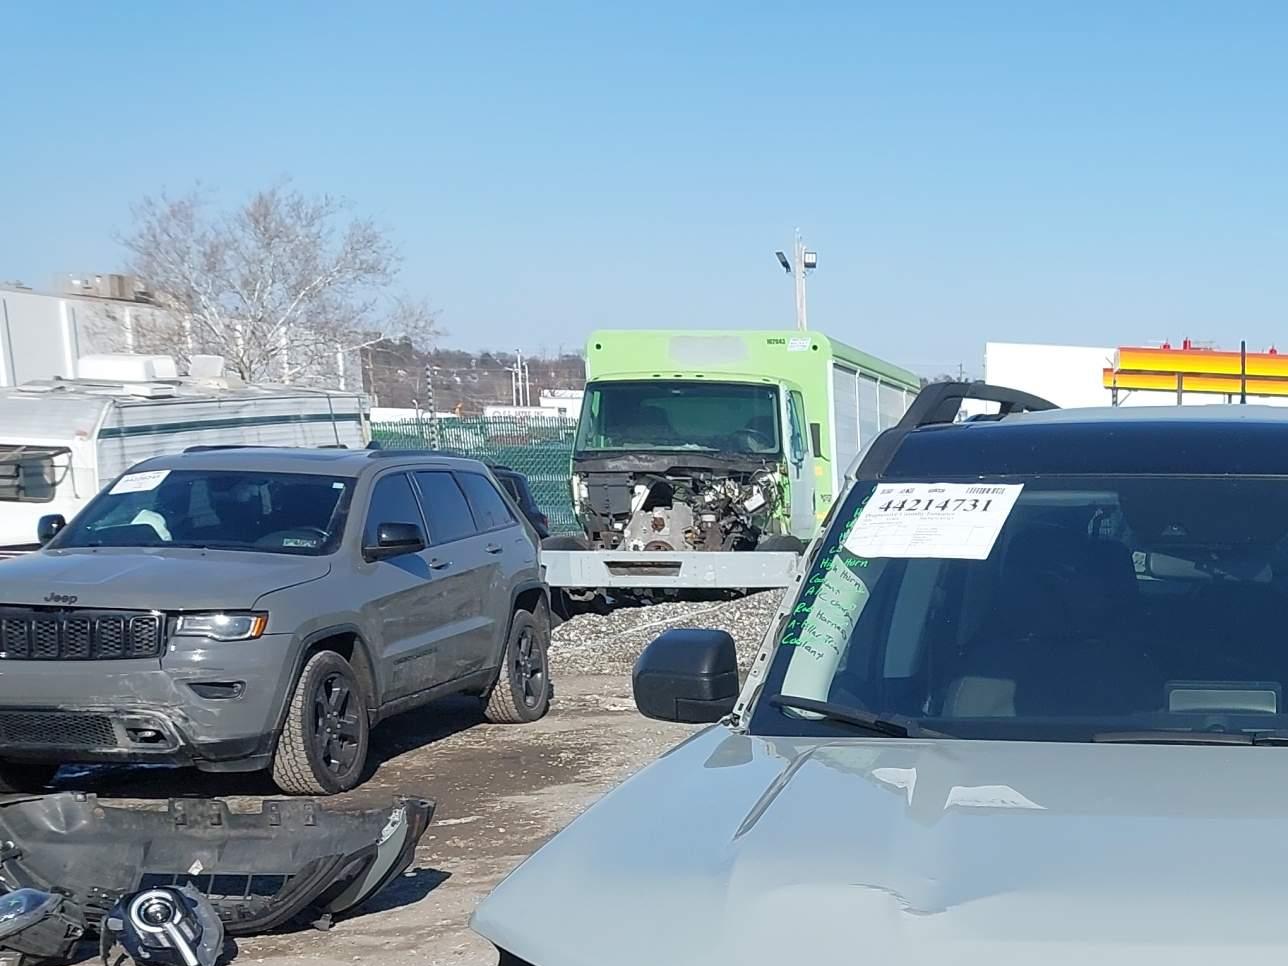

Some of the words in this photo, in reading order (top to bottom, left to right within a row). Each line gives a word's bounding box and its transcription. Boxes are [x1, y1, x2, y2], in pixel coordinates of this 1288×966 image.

[879, 498, 993, 512] 44214731
[844, 557, 869, 568] Horn
[44, 591, 78, 605] Jeep
